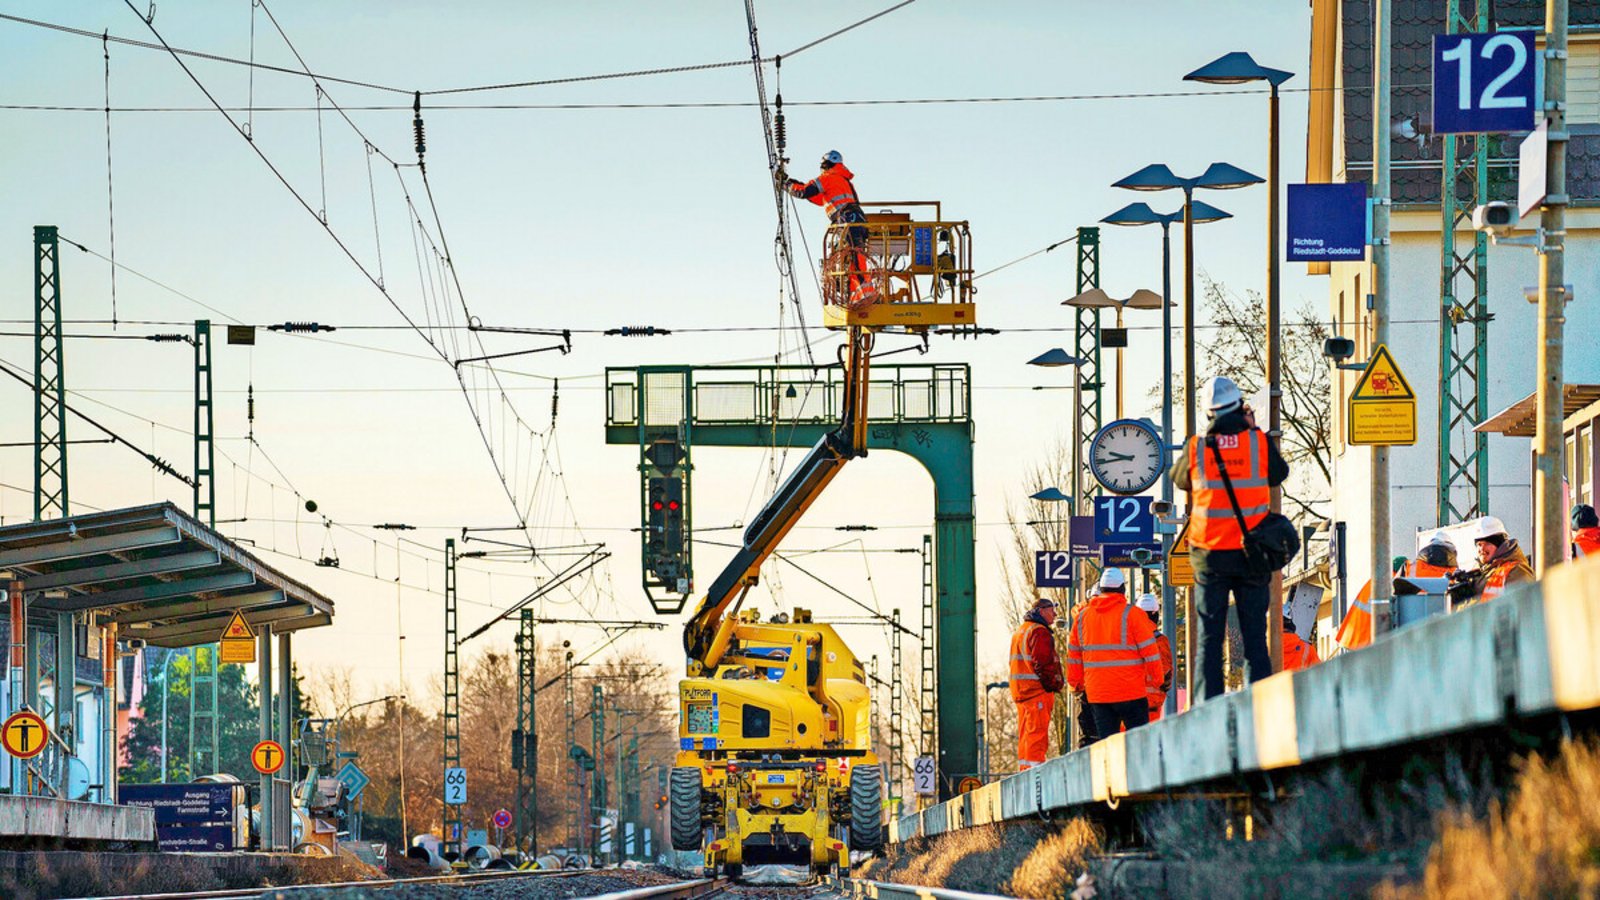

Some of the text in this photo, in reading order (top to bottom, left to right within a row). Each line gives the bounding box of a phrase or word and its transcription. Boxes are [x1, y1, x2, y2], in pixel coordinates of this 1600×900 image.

[1442, 34, 1527, 110] 12
[1293, 238, 1324, 247] Richtung
[1293, 247, 1361, 255] Riedstadt-Goddelau
[1217, 434, 1238, 448] DB
[1210, 458, 1244, 466] Psse
[1100, 498, 1141, 533] 12
[1039, 552, 1070, 580] 12
[915, 760, 933, 774] 66
[446, 770, 465, 784] 66
[920, 775, 929, 789] 2
[452, 785, 461, 799] 2
